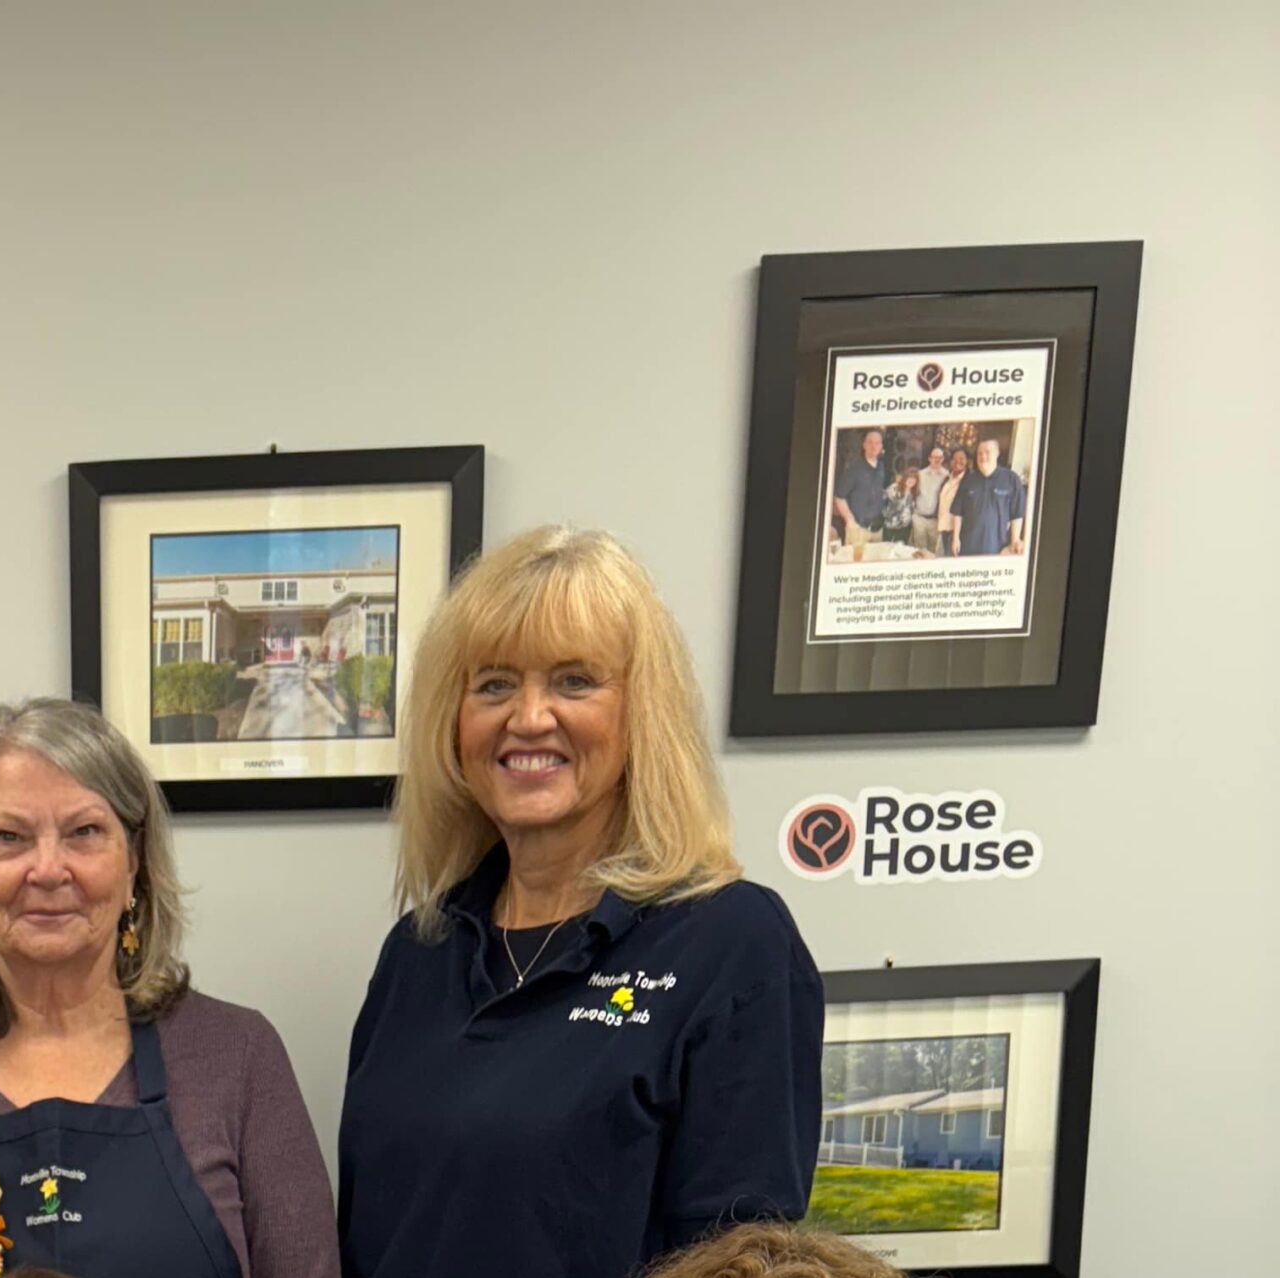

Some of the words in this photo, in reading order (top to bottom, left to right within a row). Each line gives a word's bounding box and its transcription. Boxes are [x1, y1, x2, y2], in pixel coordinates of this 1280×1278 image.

[853, 371, 909, 390] Rose
[951, 367, 1025, 385] House
[851, 396, 953, 413] Self-Directed
[957, 393, 1023, 408] Services
[949, 569, 989, 579] enabling
[991, 569, 1002, 577] us
[1004, 568, 1015, 576] to
[849, 585, 884, 594] provide
[903, 582, 934, 590] clients
[935, 580, 956, 588] with
[828, 595, 872, 604] including
[873, 592, 913, 603] personal
[915, 591, 949, 599] finance
[836, 604, 885, 614] navigating
[887, 602, 913, 611] social
[975, 598, 1006, 608] simply
[836, 614, 876, 624] enjoying
[885, 613, 902, 623] day
[903, 612, 920, 620] out
[921, 611, 930, 619] in
[865, 796, 996, 835] Rose
[863, 838, 1034, 877] House
